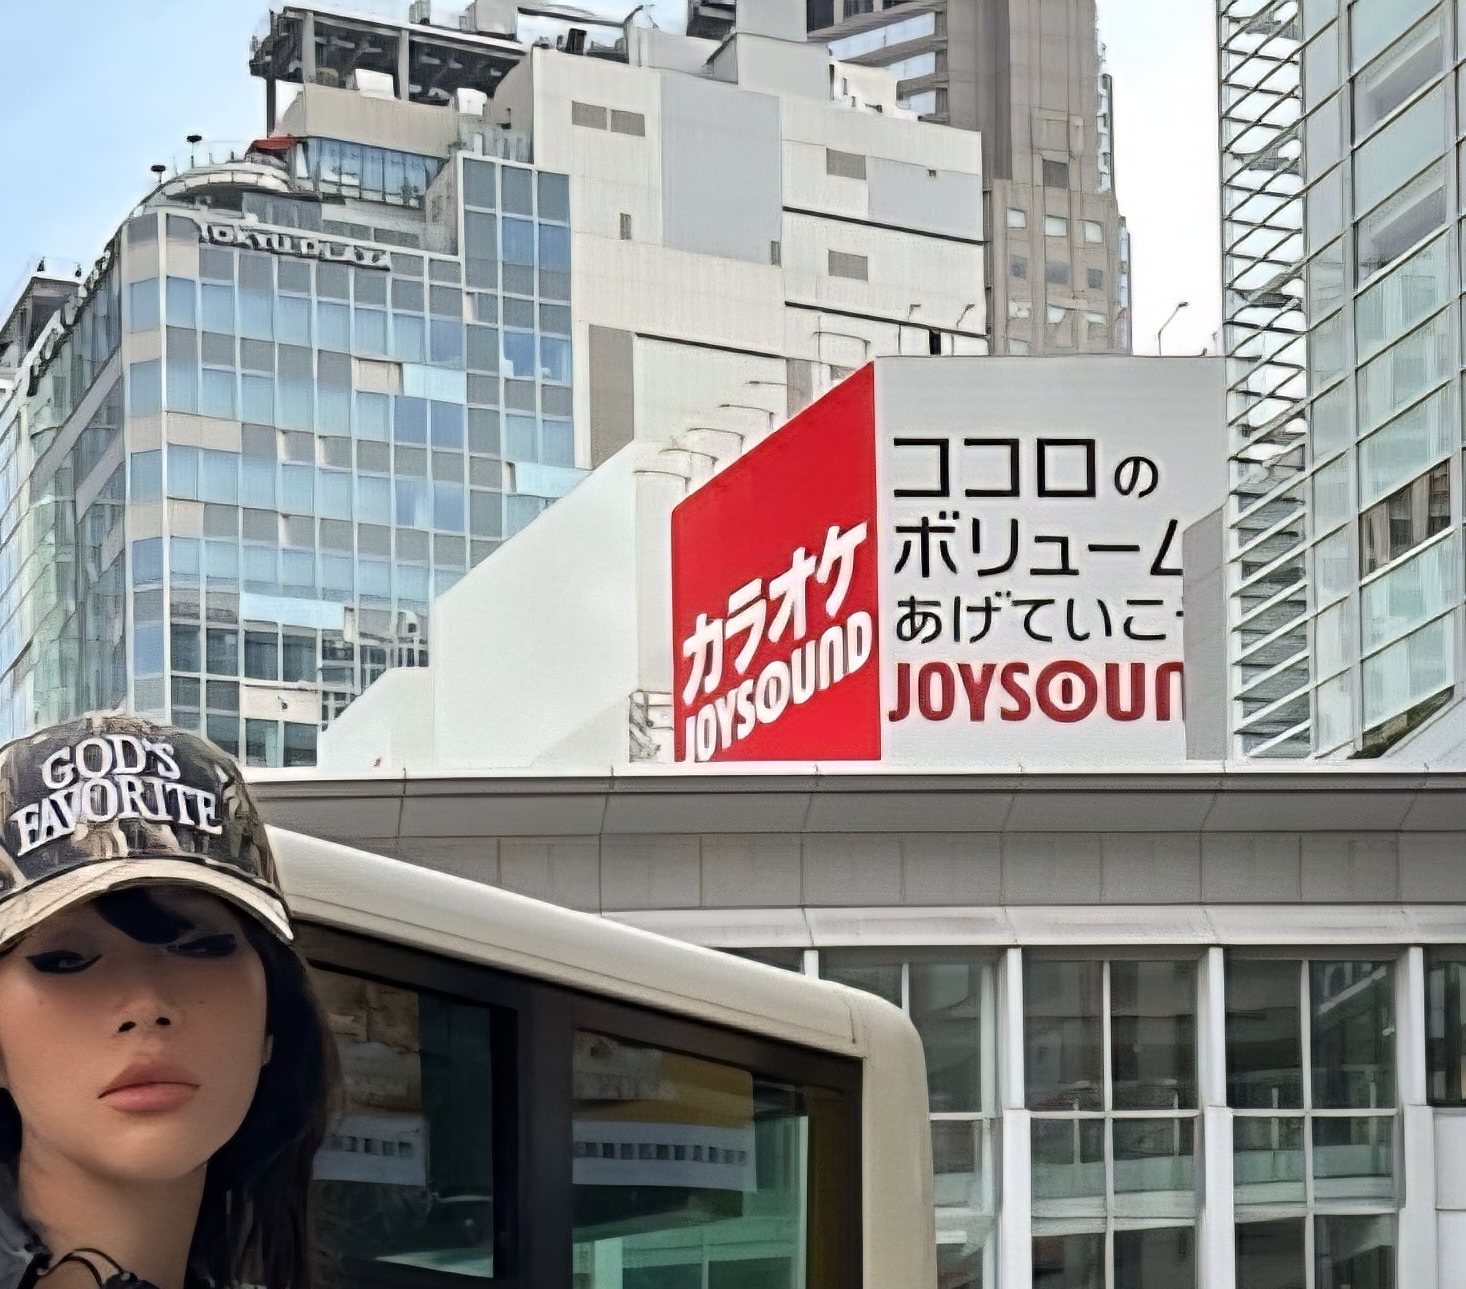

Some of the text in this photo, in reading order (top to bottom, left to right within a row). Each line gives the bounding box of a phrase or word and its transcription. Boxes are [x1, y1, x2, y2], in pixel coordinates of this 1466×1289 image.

[894, 437, 1159, 498] ココロの
[683, 520, 868, 706] カラオケ
[896, 591, 1184, 645] あげていこ
[41, 733, 182, 790] GOD'S
[9, 774, 224, 857] FAVORITE
